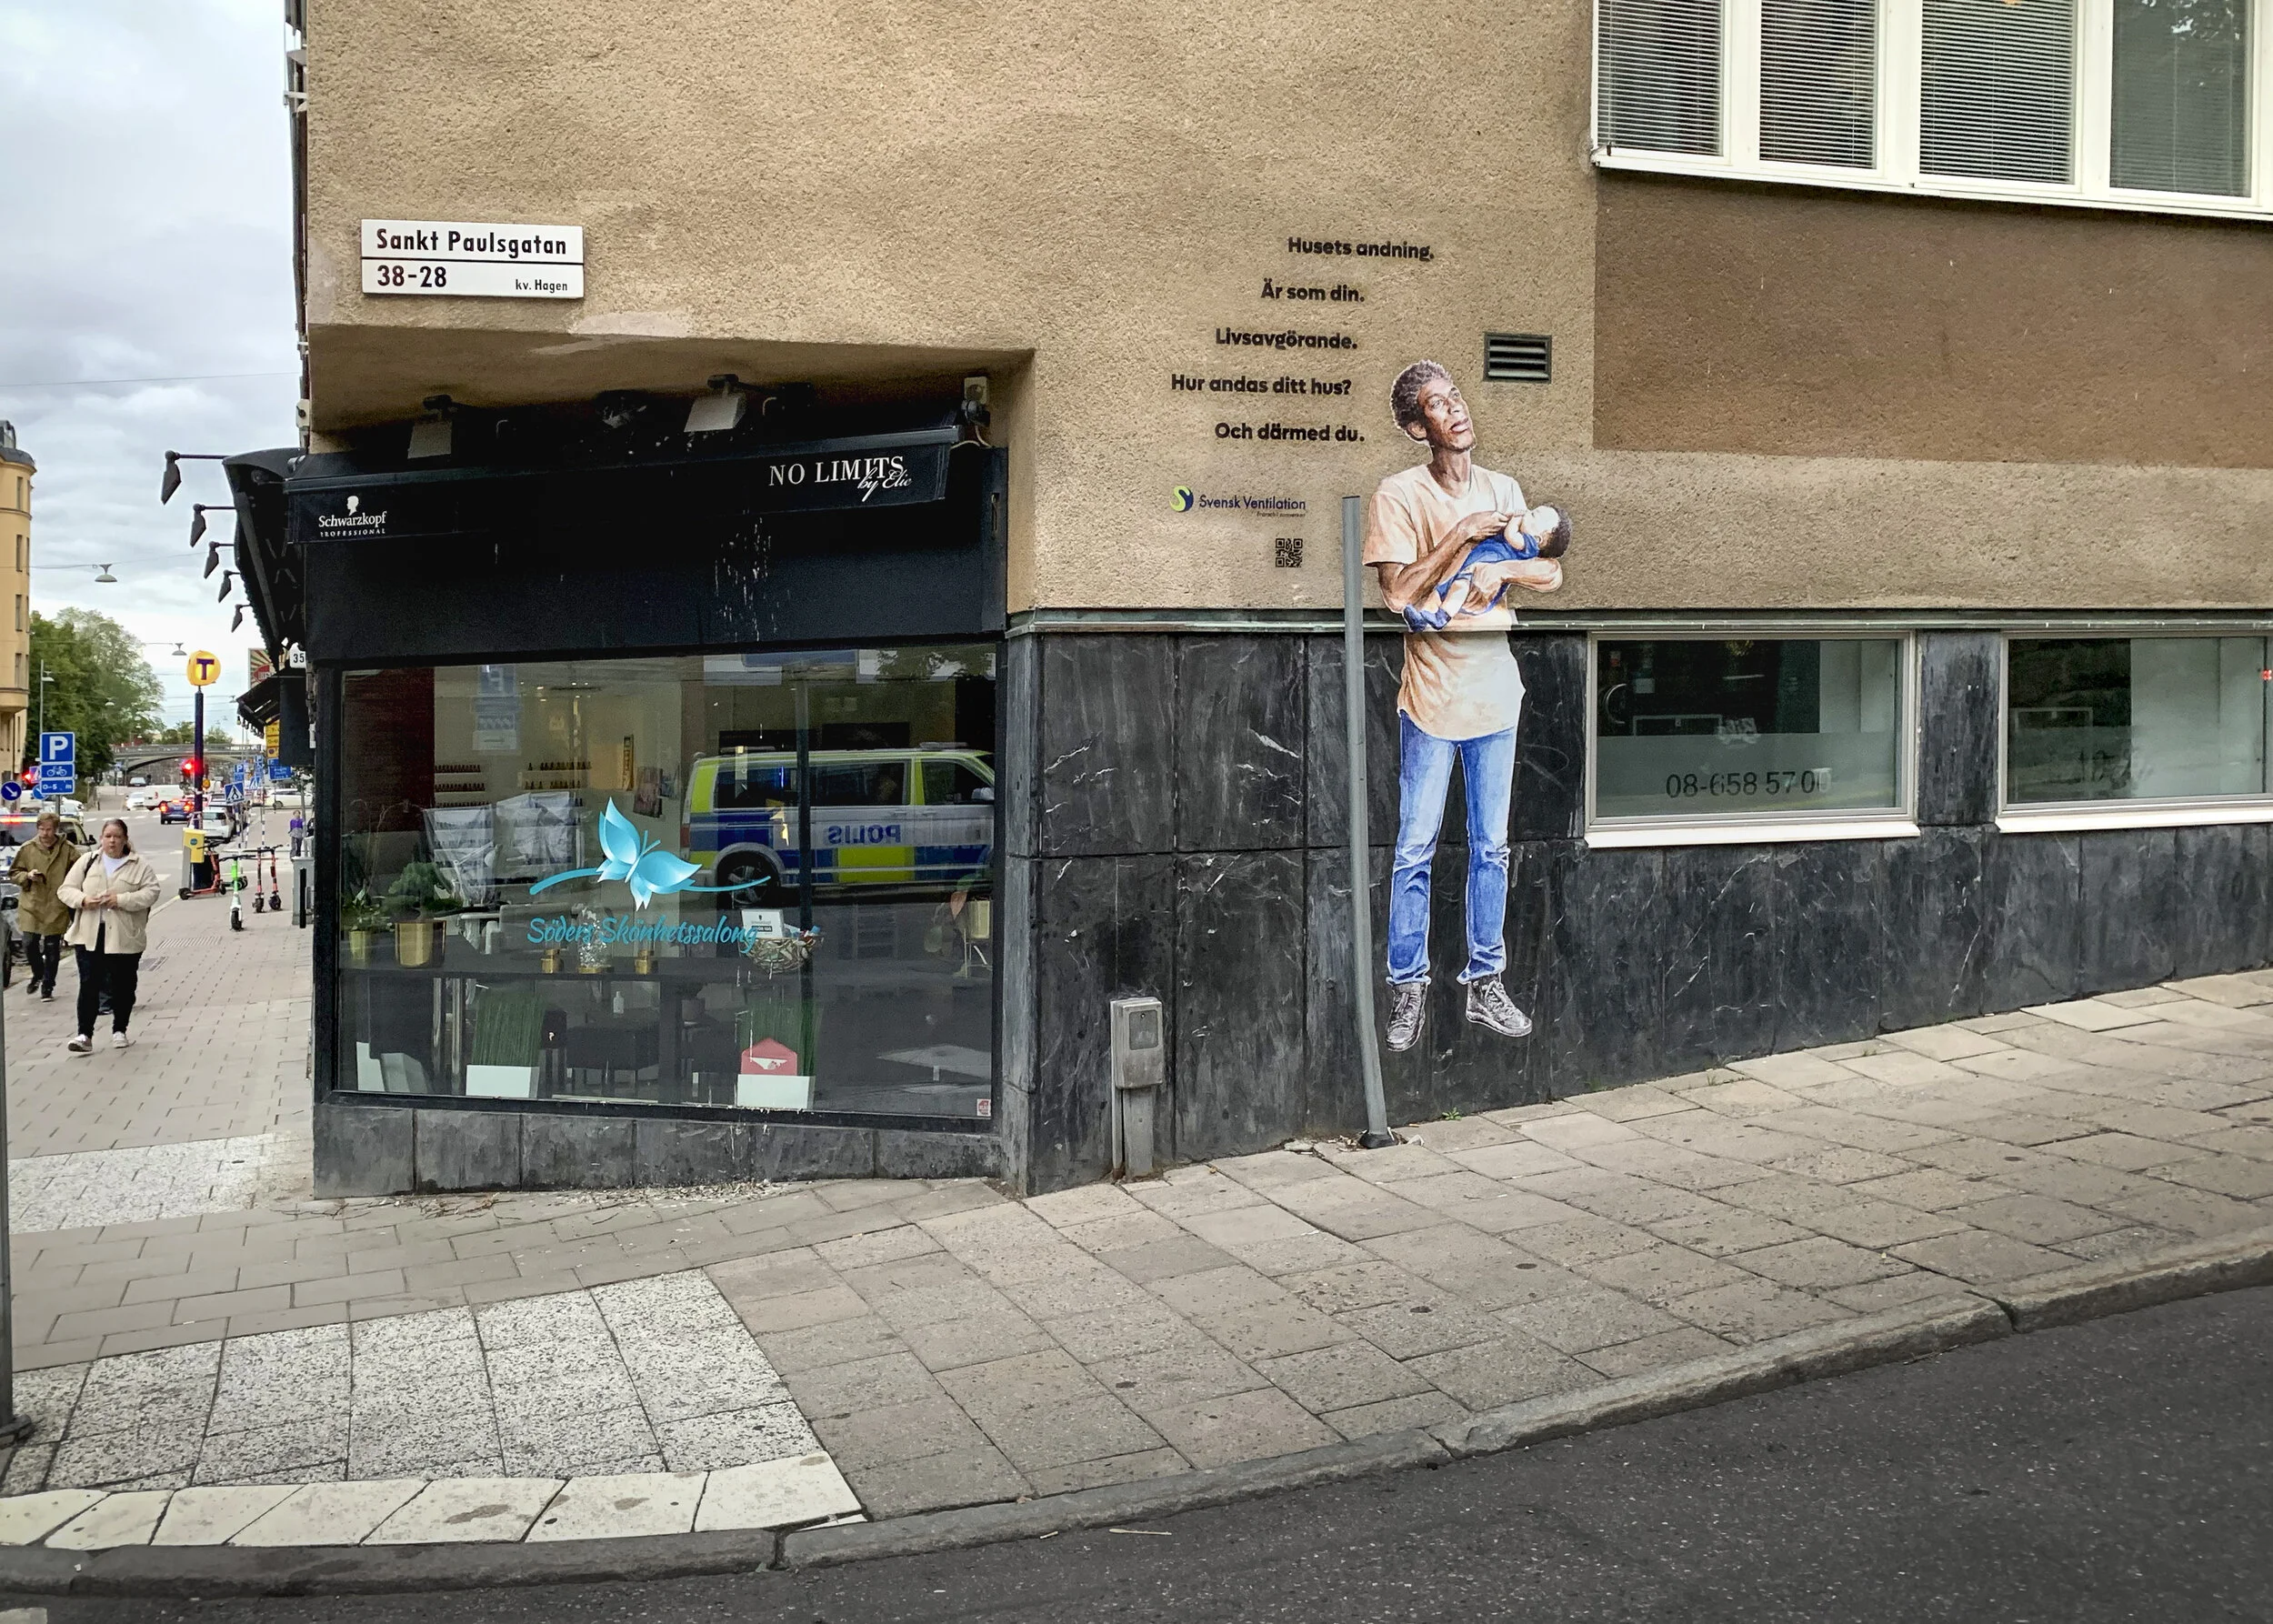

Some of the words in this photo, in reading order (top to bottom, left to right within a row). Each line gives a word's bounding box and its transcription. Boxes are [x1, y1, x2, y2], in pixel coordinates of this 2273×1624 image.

[376, 228, 438, 251] Sankt
[448, 230, 566, 259] Paulsgatan
[1288, 236, 1352, 256] Husets
[1356, 241, 1435, 262] andning.
[377, 265, 447, 288] 38-28
[516, 279, 532, 291] kv.
[535, 279, 567, 294] Hagen
[1261, 278, 1283, 299] Är
[1287, 286, 1326, 301] som
[1330, 285, 1365, 302] din.
[1216, 327, 1357, 350] Livsavgörande.
[1171, 374, 1206, 391] Hur
[1209, 376, 1268, 393] andas
[1272, 376, 1306, 394] ditt
[1311, 378, 1352, 396] hus?
[1215, 423, 1253, 440] Och
[1257, 425, 1330, 442] därmed
[1335, 426, 1365, 442] du.
[768, 464, 806, 486] NO
[815, 456, 904, 483] LIMITS
[856, 466, 878, 502] by
[1199, 495, 1241, 508] Svensk
[1243, 495, 1306, 510] Ventilation
[318, 511, 386, 527] Schwarzkopf
[320, 528, 386, 537] PROFESSIONAL
[195, 657, 215, 680] T
[293, 653, 305, 664] 35
[49, 736, 69, 760] P
[1666, 771, 1757, 798] 08-658
[526, 915, 594, 945] Söders
[598, 915, 759, 954] Skönhetssalong
